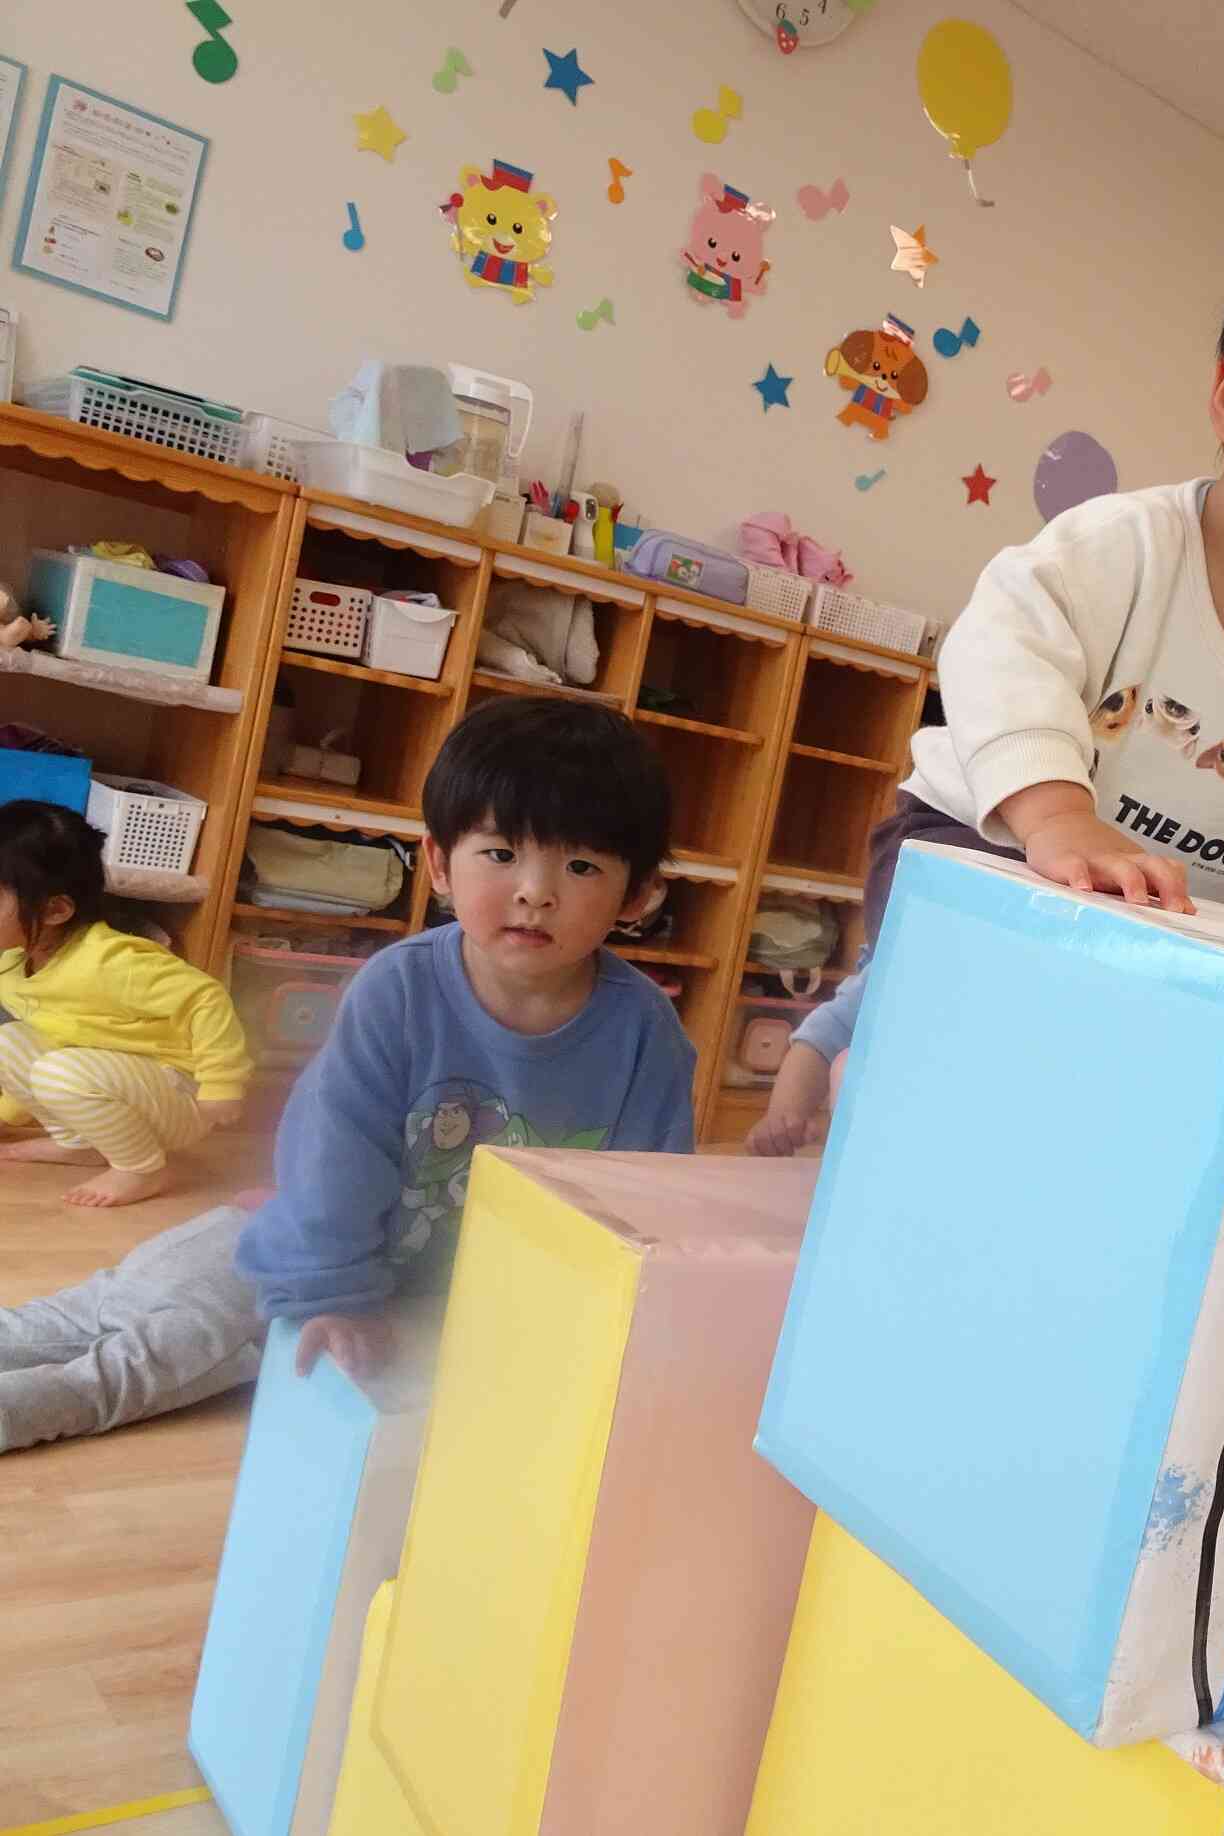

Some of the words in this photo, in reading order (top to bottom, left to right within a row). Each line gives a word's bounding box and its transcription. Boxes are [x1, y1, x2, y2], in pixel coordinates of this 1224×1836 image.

[776, 2, 786, 20] 6
[799, 8, 810, 26] 5
[1115, 794, 1182, 844] THE
